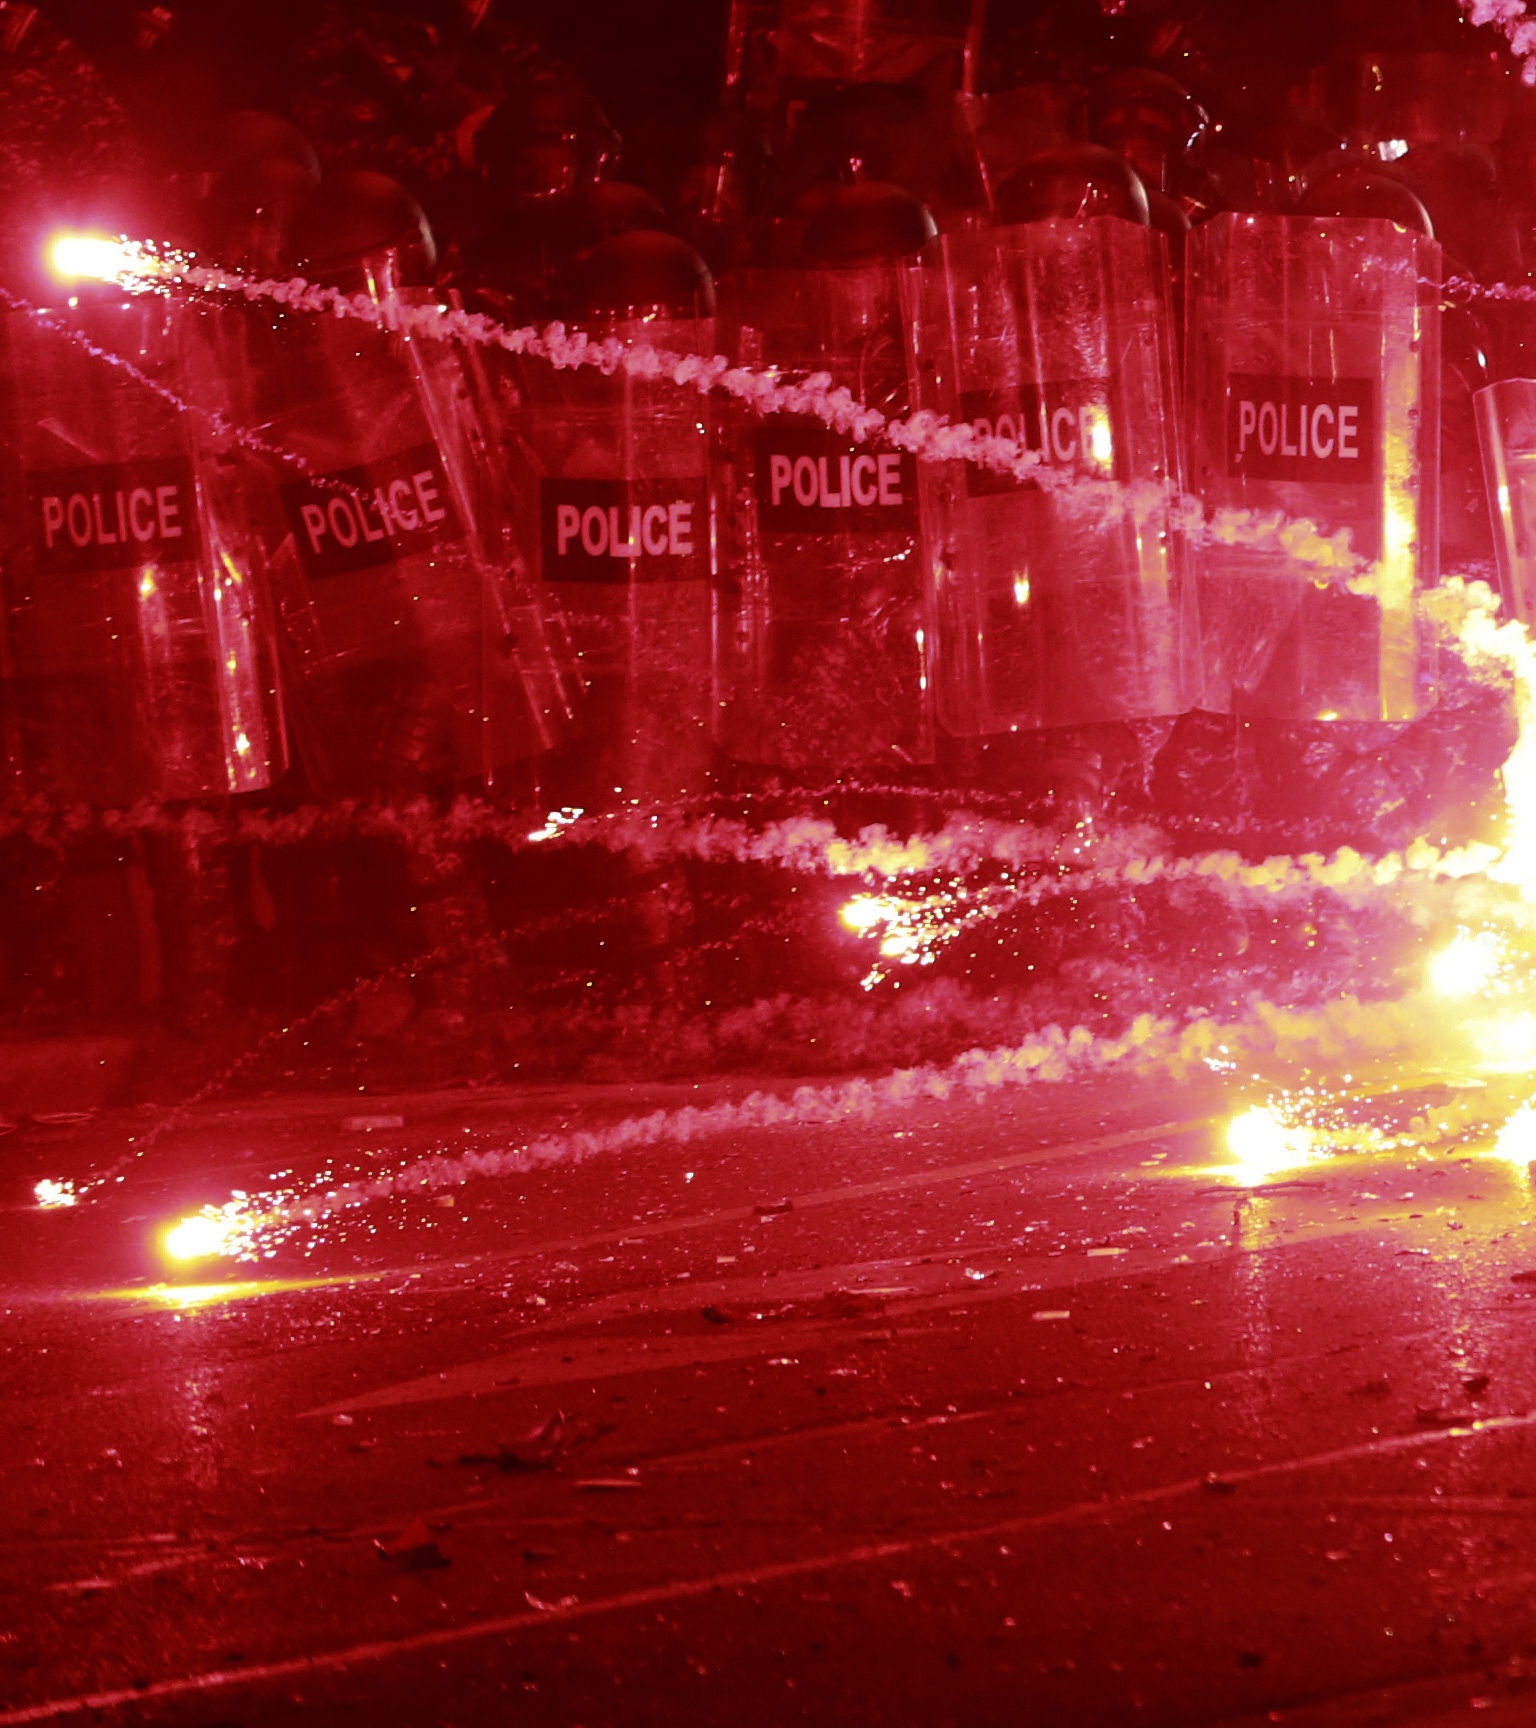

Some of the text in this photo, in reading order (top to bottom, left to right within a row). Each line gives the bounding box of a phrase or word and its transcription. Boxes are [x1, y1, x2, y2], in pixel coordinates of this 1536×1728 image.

[1239, 401, 1359, 459] POLICE
[770, 453, 902, 508] POLICE
[42, 485, 182, 548] POLICE
[301, 471, 446, 553] POLICE
[556, 503, 693, 558] POLICE
